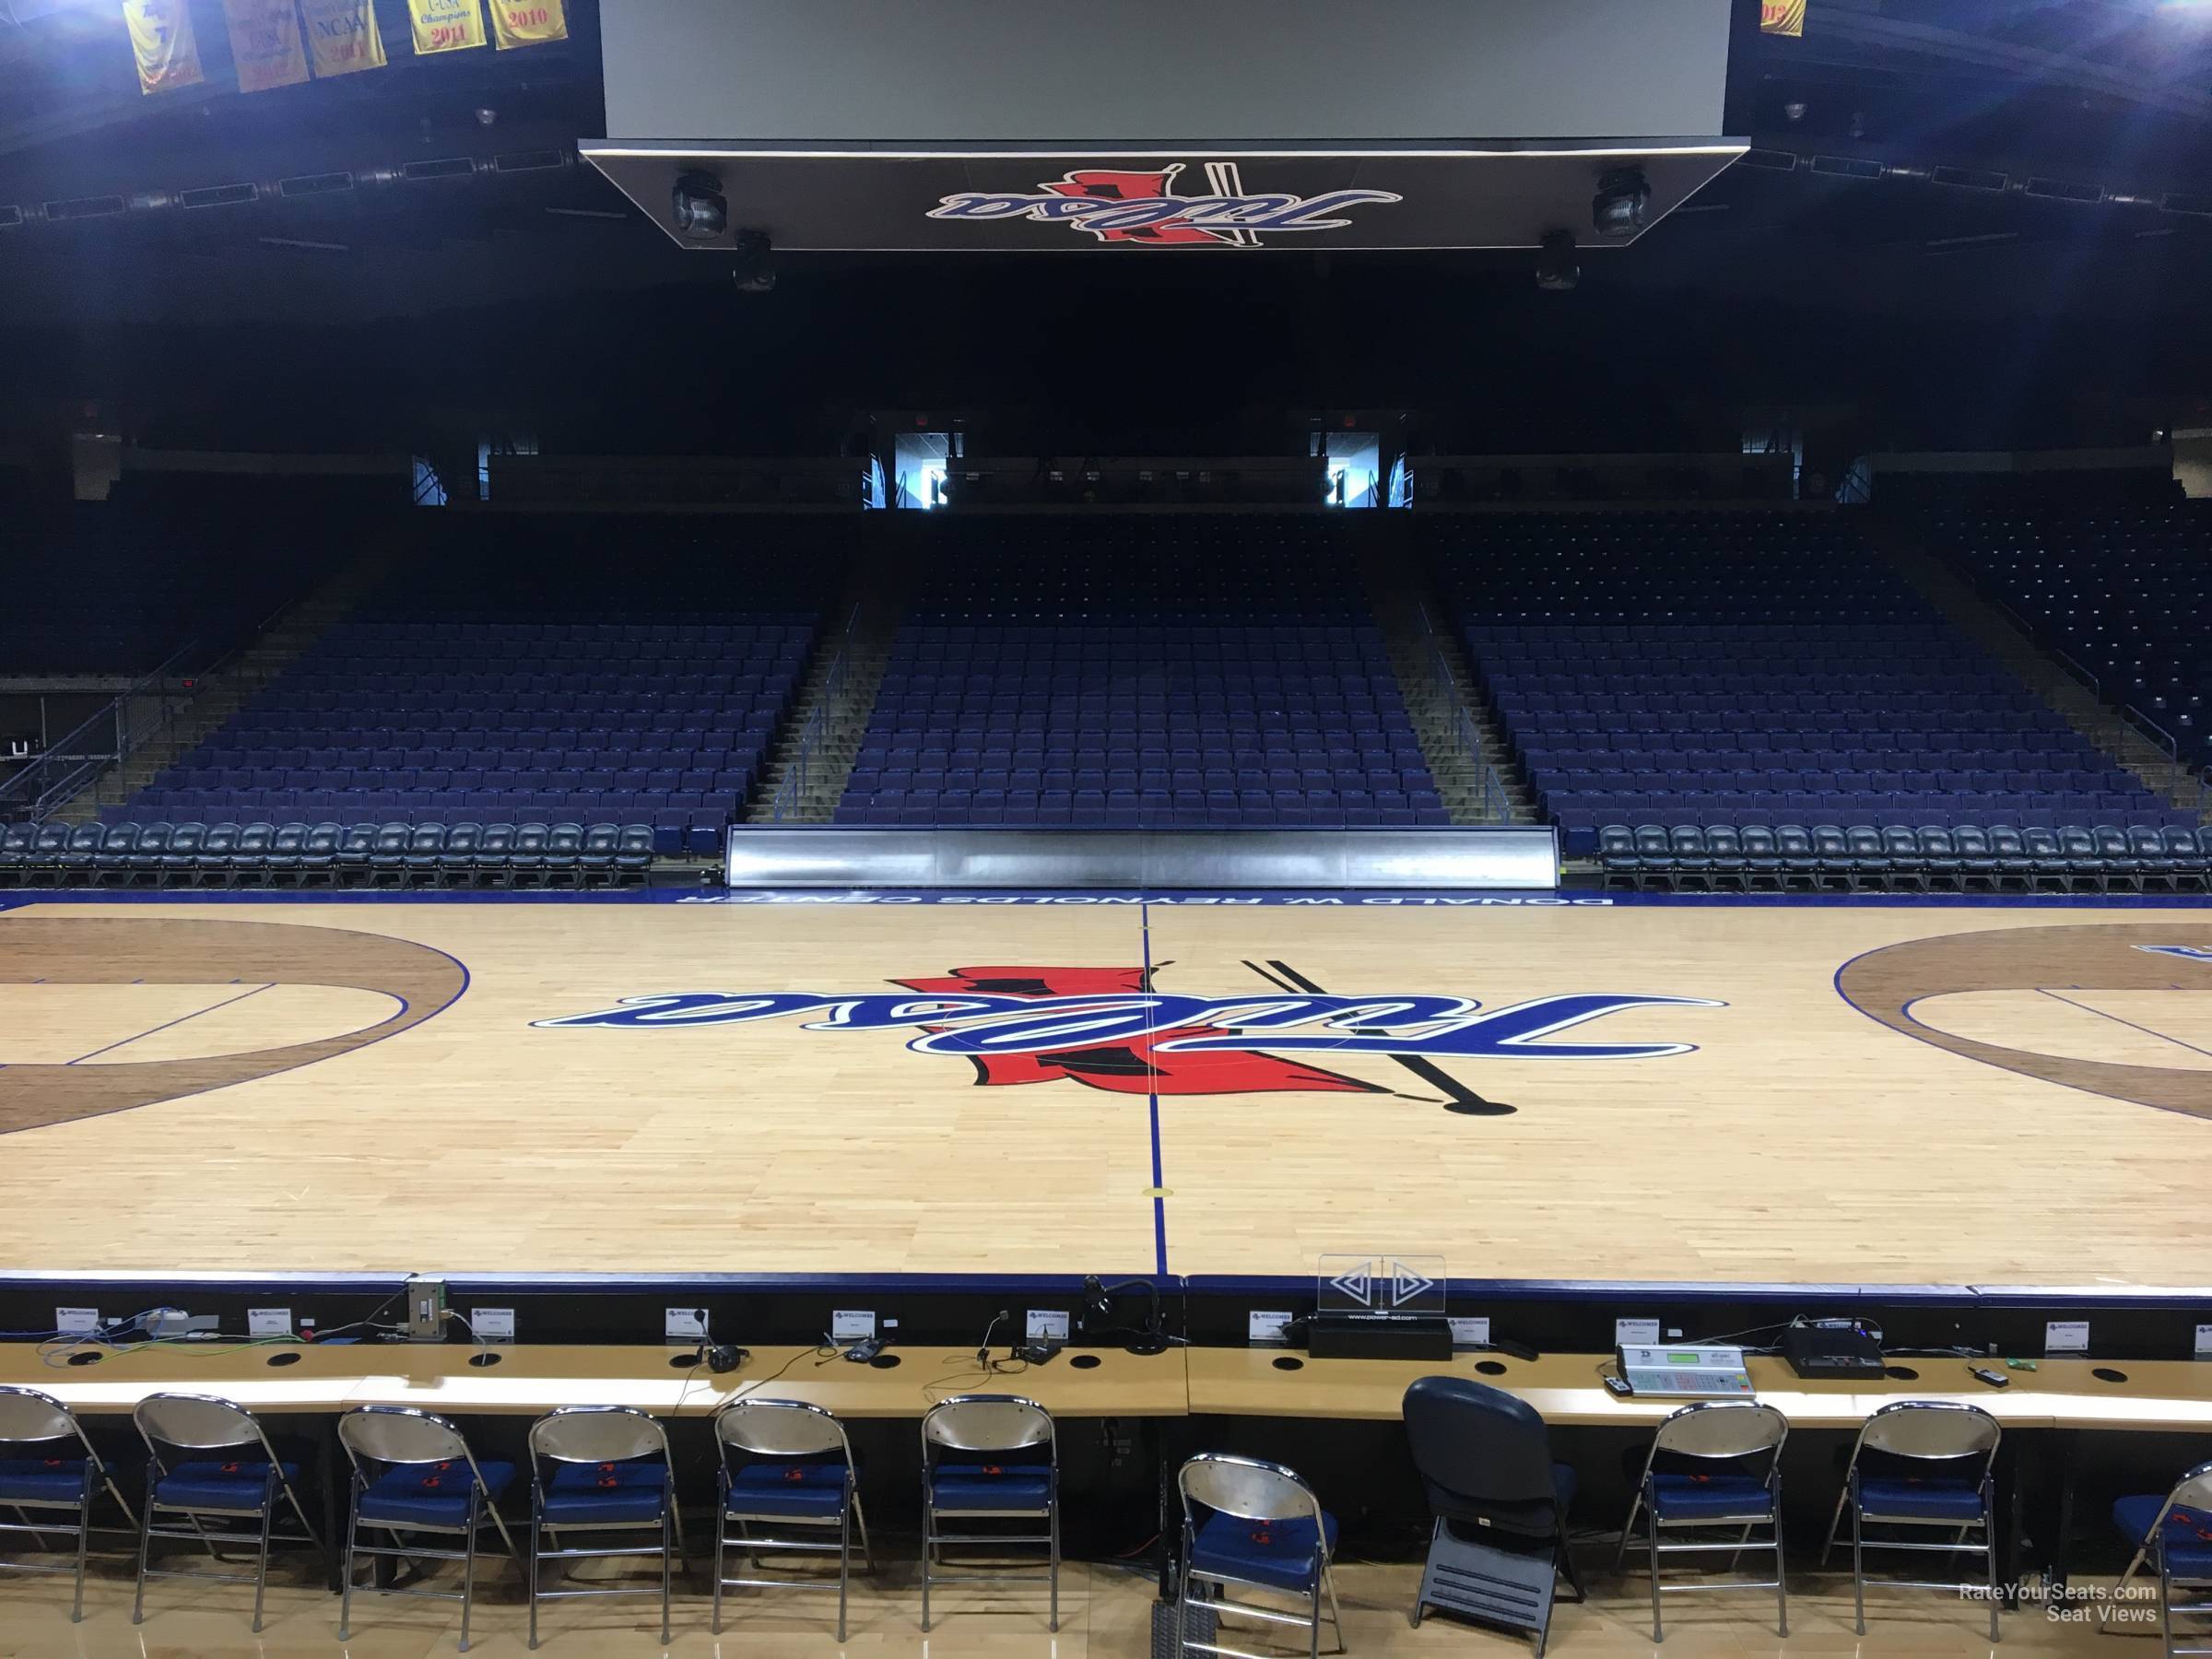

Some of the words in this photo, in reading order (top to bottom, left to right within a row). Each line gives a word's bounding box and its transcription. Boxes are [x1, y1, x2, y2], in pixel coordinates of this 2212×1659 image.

[316, 14, 366, 38] NCAA
[421, 10, 471, 24] Champions
[508, 7, 548, 29] 2010
[430, 23, 466, 45] 2011
[925, 188, 1404, 230] Tulsa
[528, 991, 1730, 1060] Tulsa
